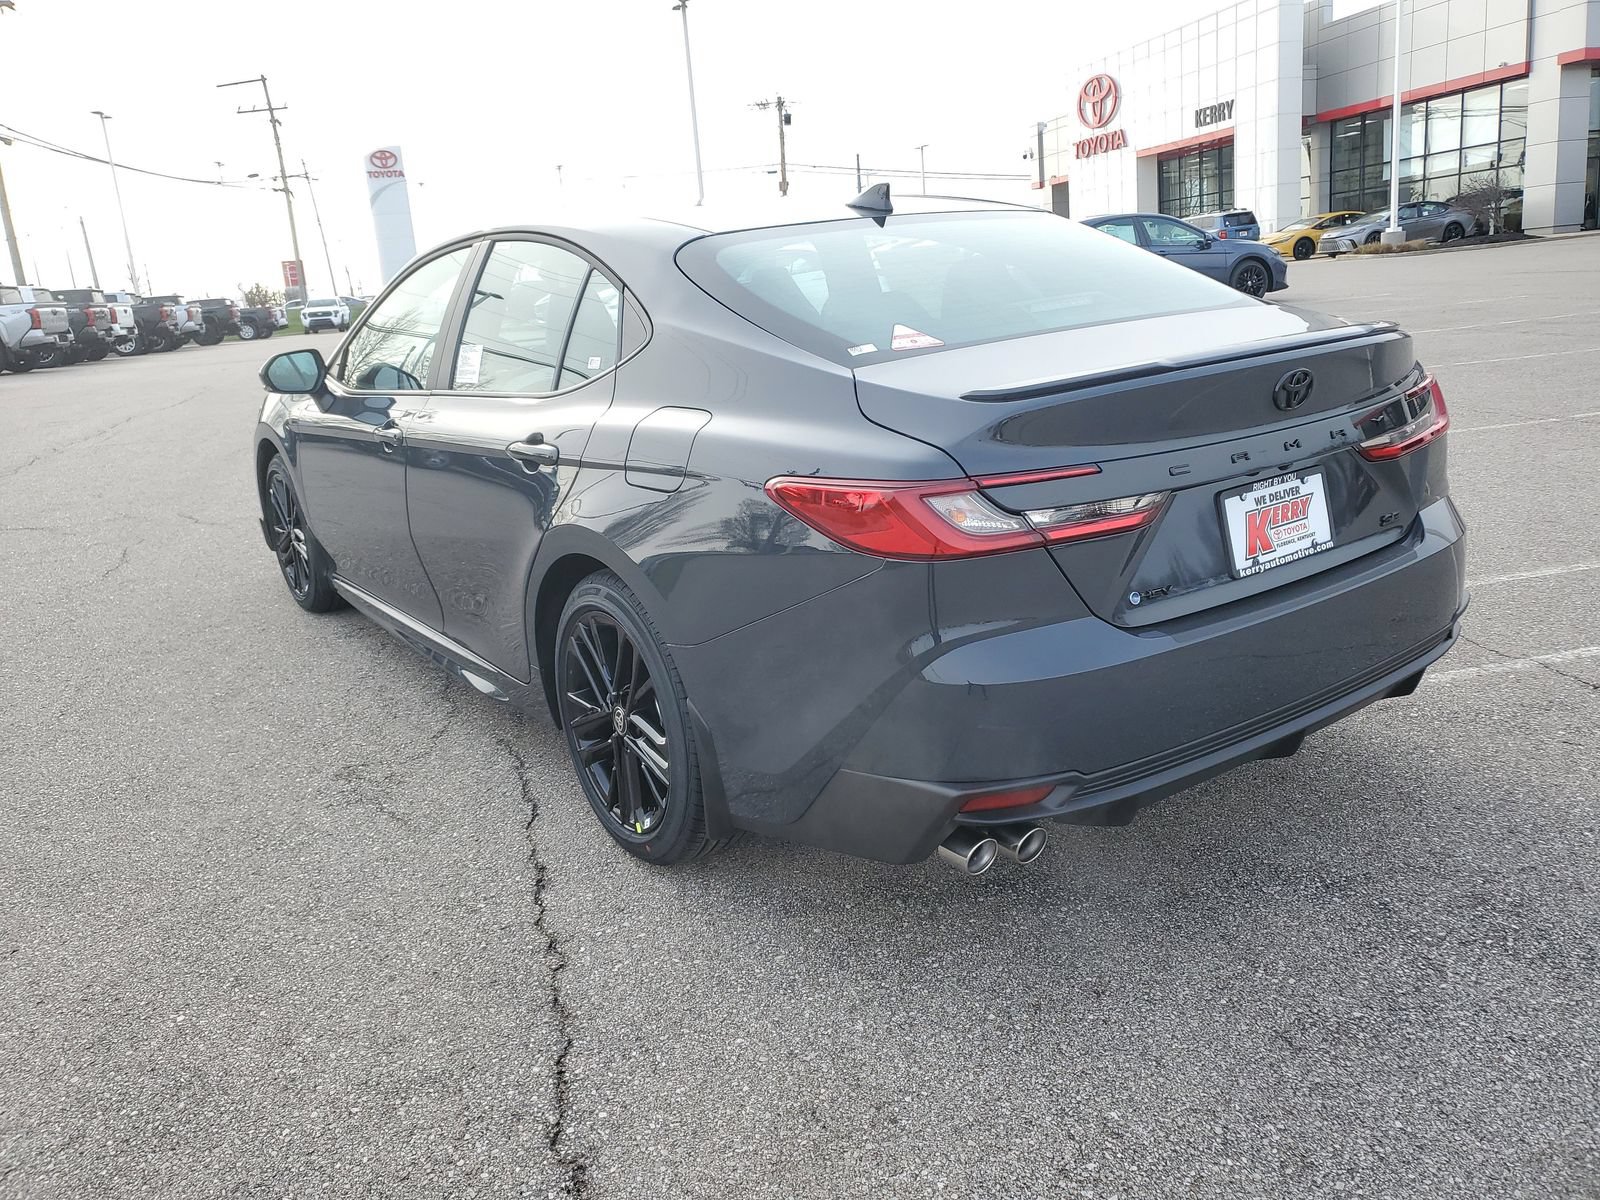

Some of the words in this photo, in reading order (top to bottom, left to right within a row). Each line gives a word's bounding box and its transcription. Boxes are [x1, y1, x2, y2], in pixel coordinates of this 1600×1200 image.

[1195, 99, 1235, 128] KERRY
[1073, 129, 1128, 160] TOYOTA
[367, 170, 405, 178] TOYOTA
[1253, 480, 1273, 491] RIGHT
[1274, 476, 1283, 485] BY
[1283, 472, 1297, 483] YOU
[1254, 494, 1267, 507] WE
[1269, 486, 1301, 502] DELIVER
[1246, 494, 1312, 559] KERRY
[1283, 523, 1308, 536] TOYOTA
[1297, 532, 1316, 542] KENTUCKY
[1239, 541, 1334, 577] kerryautomotive.com
